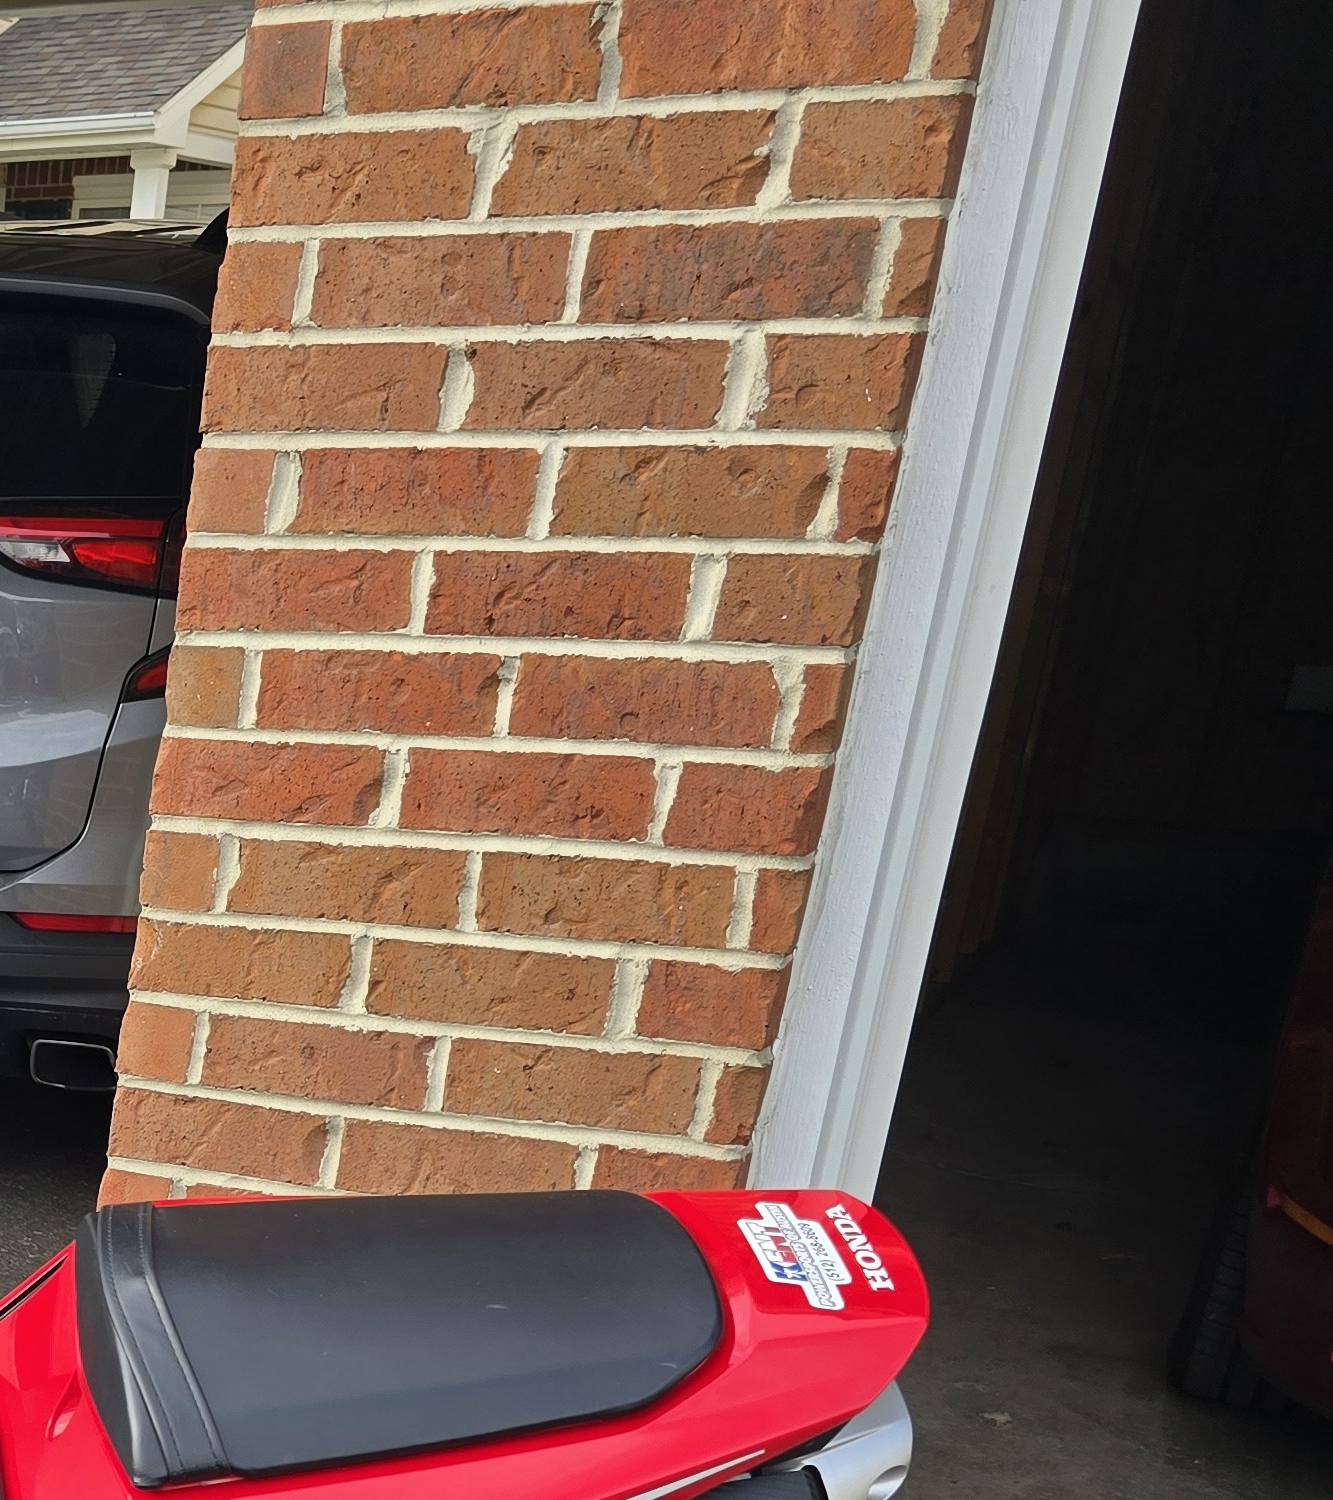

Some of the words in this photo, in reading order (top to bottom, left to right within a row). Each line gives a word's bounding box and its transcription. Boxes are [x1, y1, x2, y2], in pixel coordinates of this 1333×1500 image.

[764, 1204, 792, 1231] AUSTIN
[824, 1203, 895, 1291] HONDA
[745, 1222, 808, 1281] KENT
[789, 1241, 837, 1307] POWERSPORTS
[818, 1260, 845, 1281] (512)
